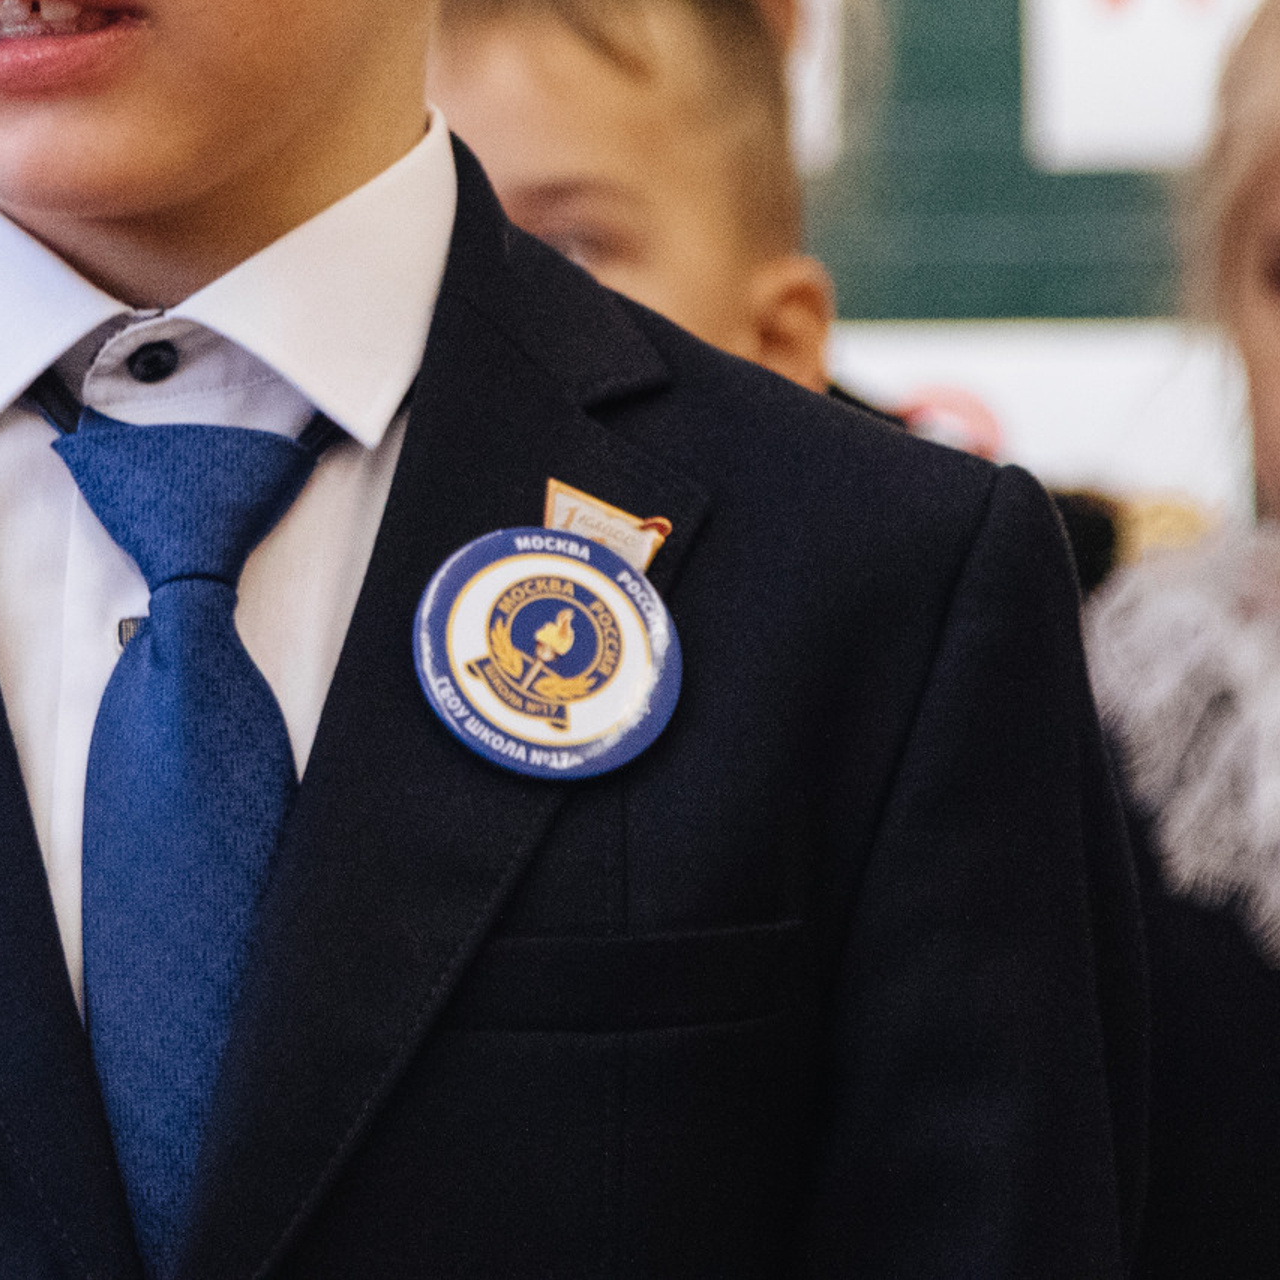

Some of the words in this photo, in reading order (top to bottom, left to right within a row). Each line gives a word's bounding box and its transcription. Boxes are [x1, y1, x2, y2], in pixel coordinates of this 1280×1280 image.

[498, 578, 576, 615] МОСКВА
[588, 601, 622, 676] РОССИЯ
[515, 535, 590, 561] МОСКВА
[616, 570, 667, 639] РОССИ
[434, 675, 469, 721] ГБОУ
[463, 718, 527, 763] ШКОЛА
